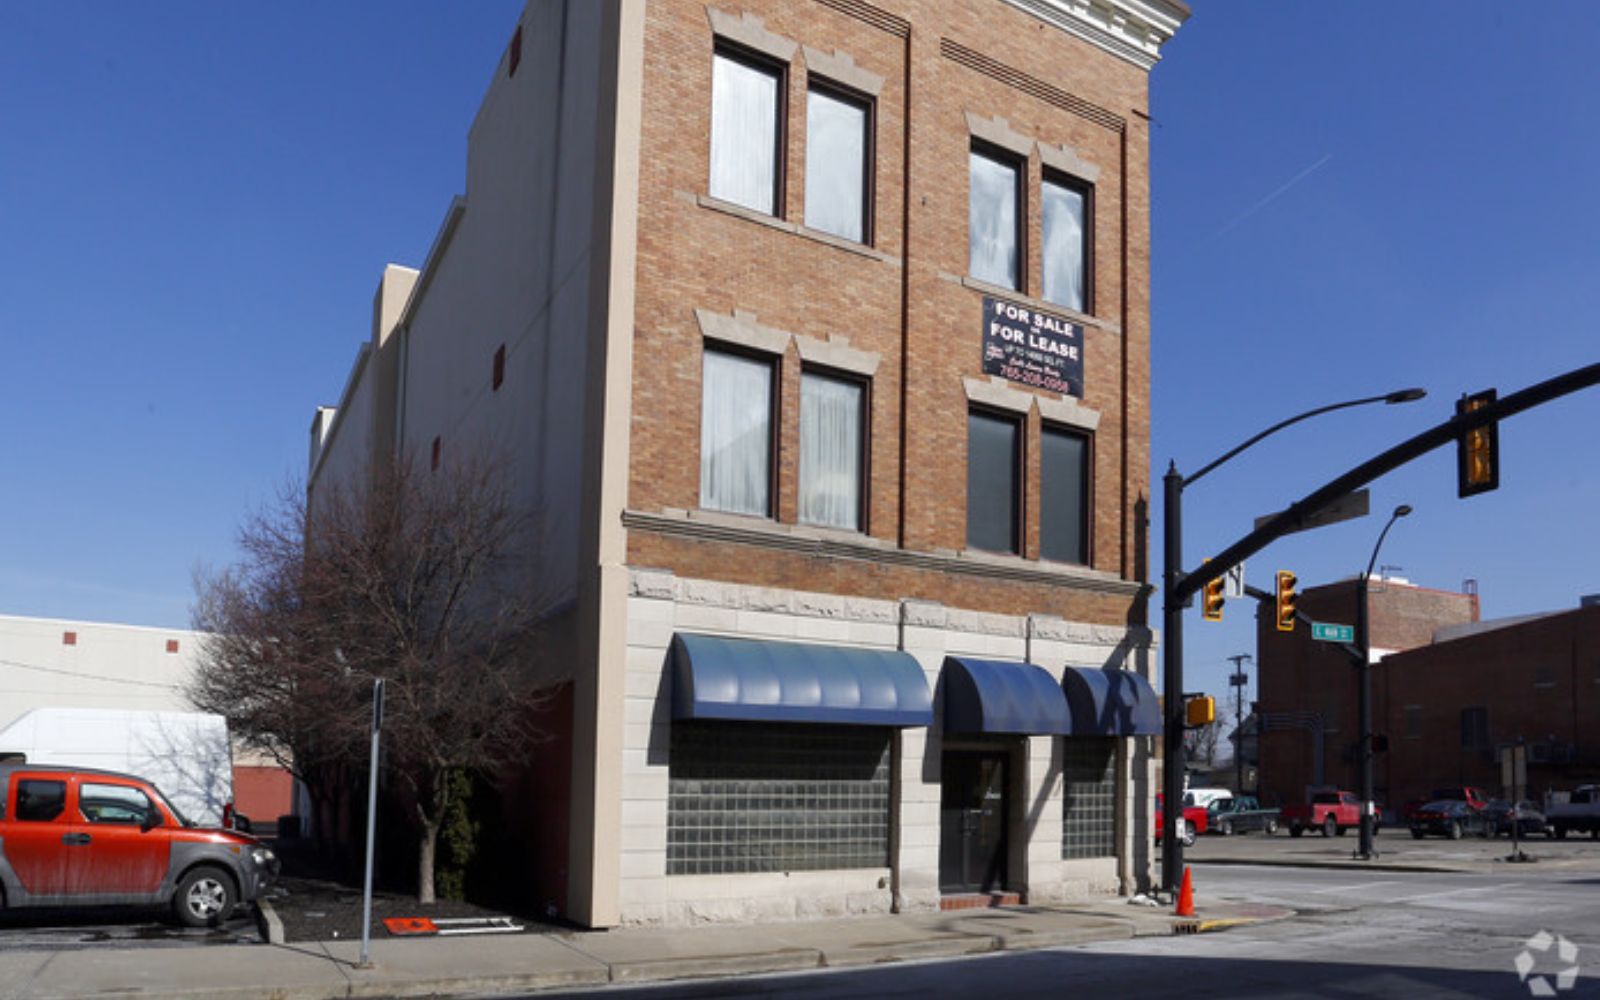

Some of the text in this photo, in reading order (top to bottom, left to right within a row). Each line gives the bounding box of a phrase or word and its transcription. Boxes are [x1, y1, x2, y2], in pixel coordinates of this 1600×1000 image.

[995, 302, 1074, 338] FOR SALE
[990, 321, 1025, 344] FOR
[1029, 334, 1078, 361] LEASE
